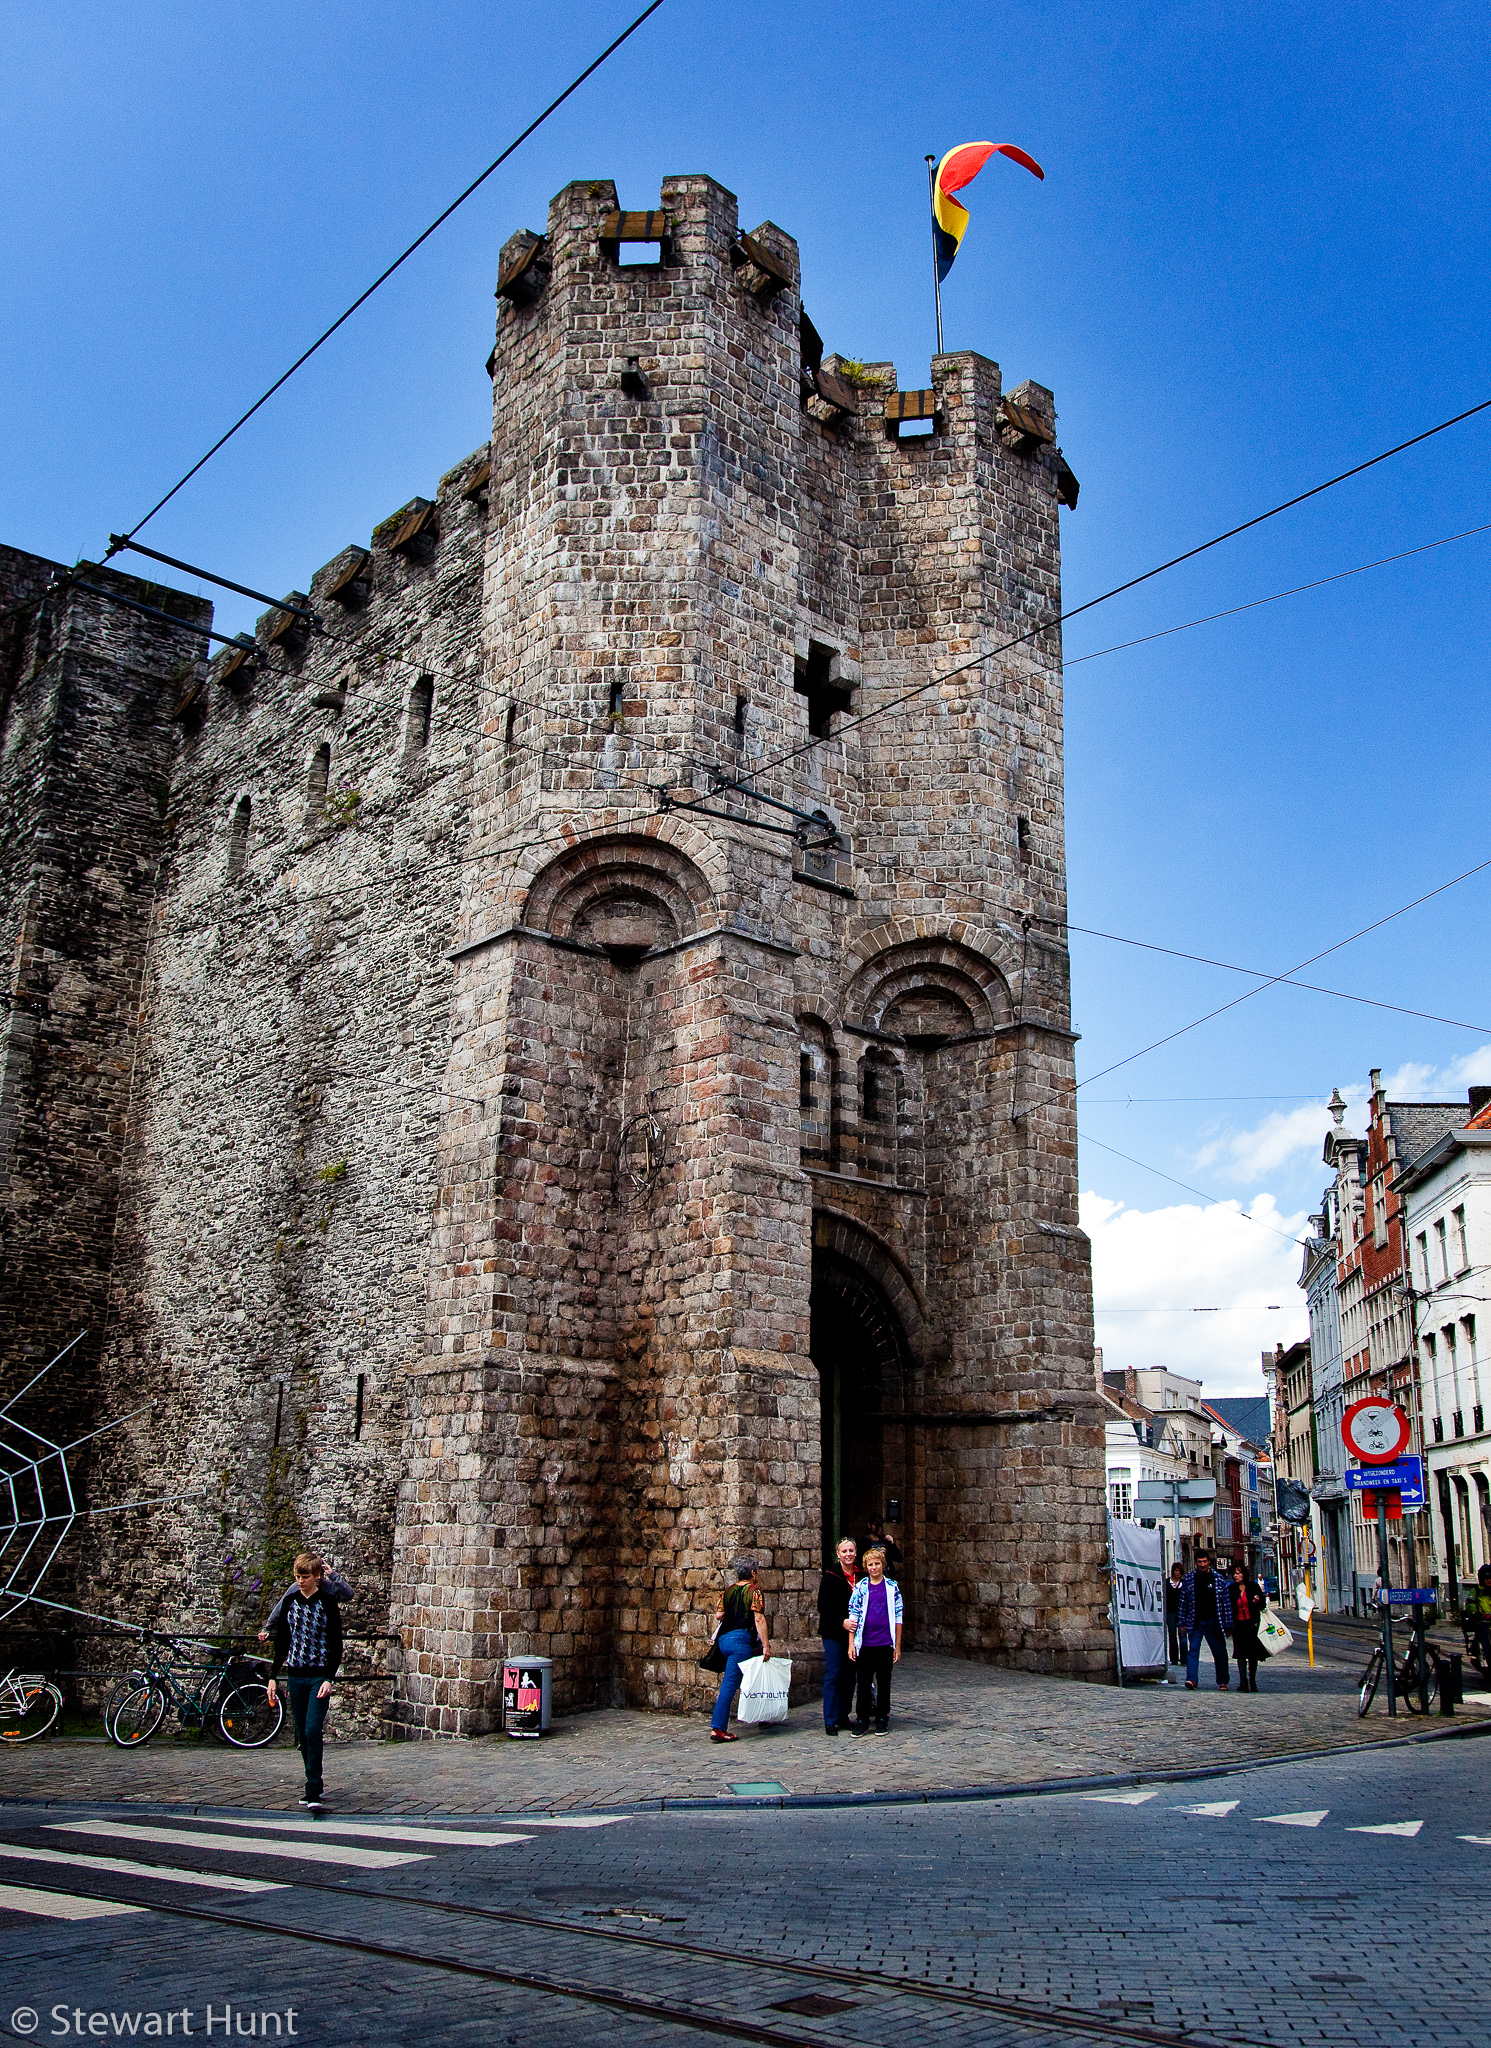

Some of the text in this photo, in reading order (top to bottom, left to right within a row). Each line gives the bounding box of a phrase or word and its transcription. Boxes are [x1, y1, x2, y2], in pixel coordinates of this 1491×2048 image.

[1362, 1469, 1395, 1477] UITGEZONDERD
[1353, 1479, 1381, 1487] BRANDWEER
[1116, 1573, 1162, 1612] DENYS
